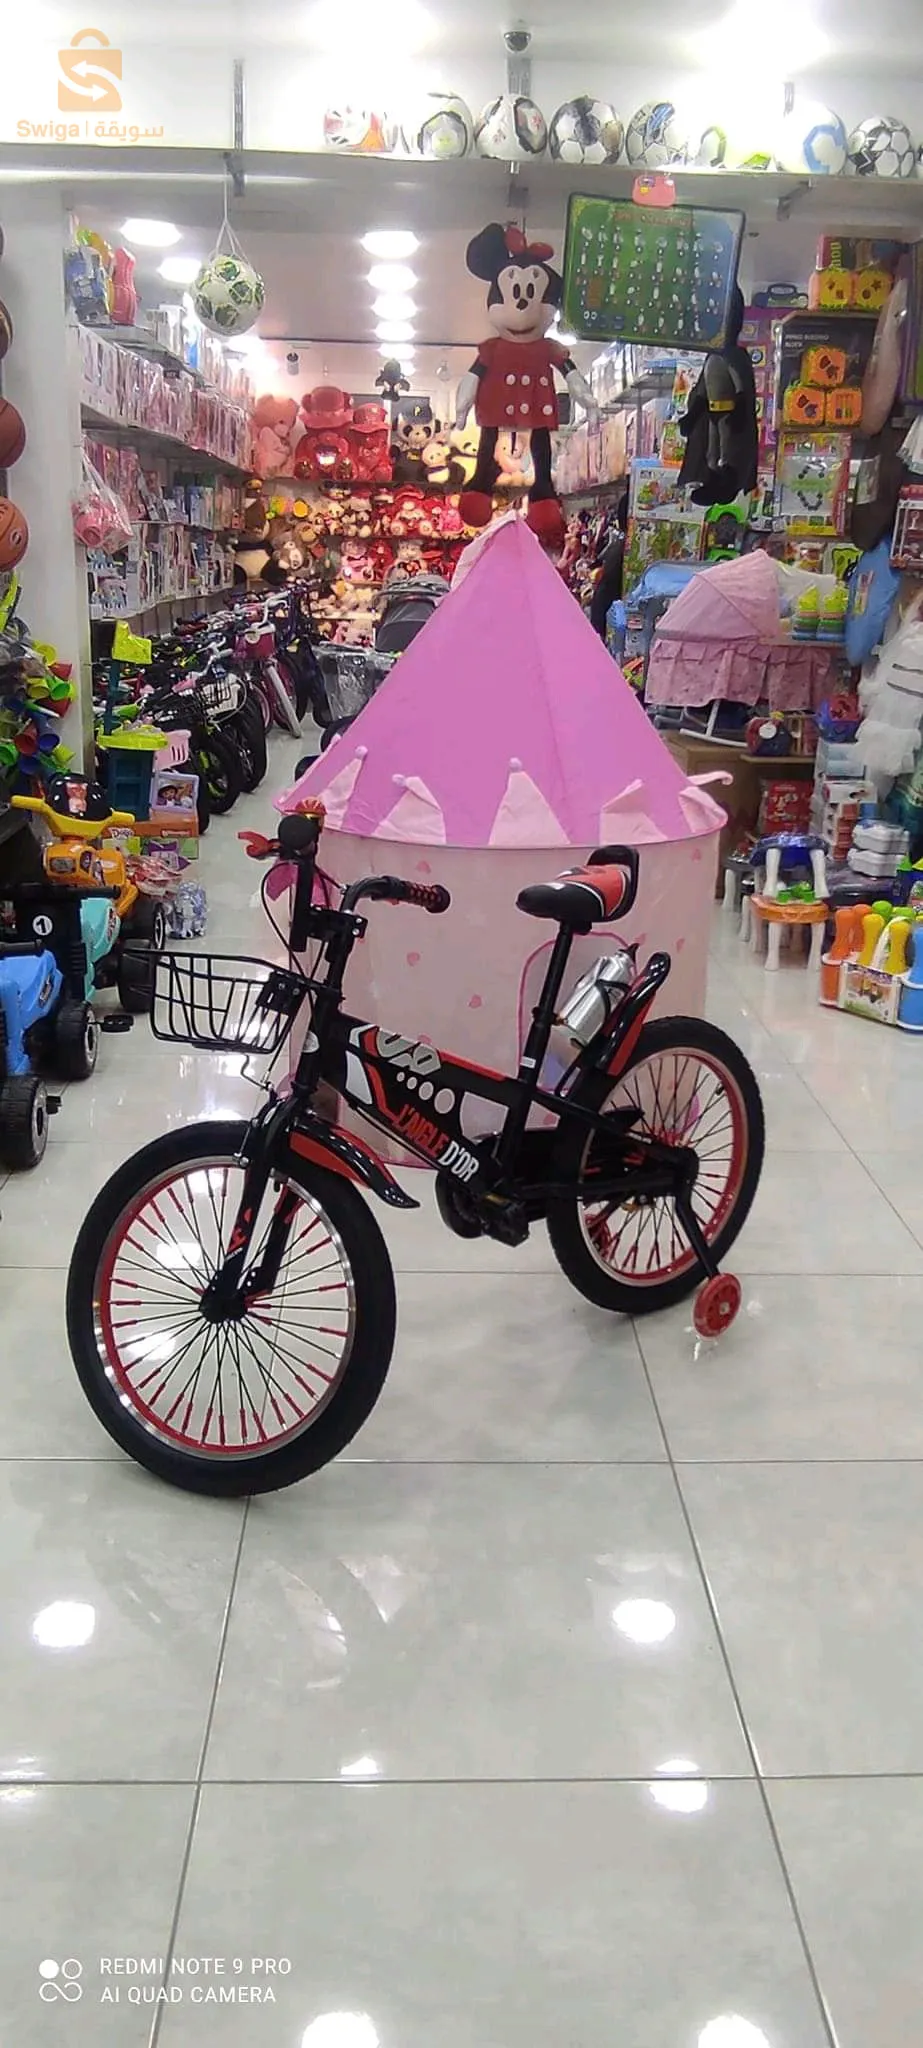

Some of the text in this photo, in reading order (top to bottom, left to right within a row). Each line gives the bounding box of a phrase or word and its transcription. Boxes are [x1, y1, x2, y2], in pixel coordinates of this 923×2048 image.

[36, 917, 47, 934] 1
[393, 1103, 480, 1182] L'AIGLE D'OR
